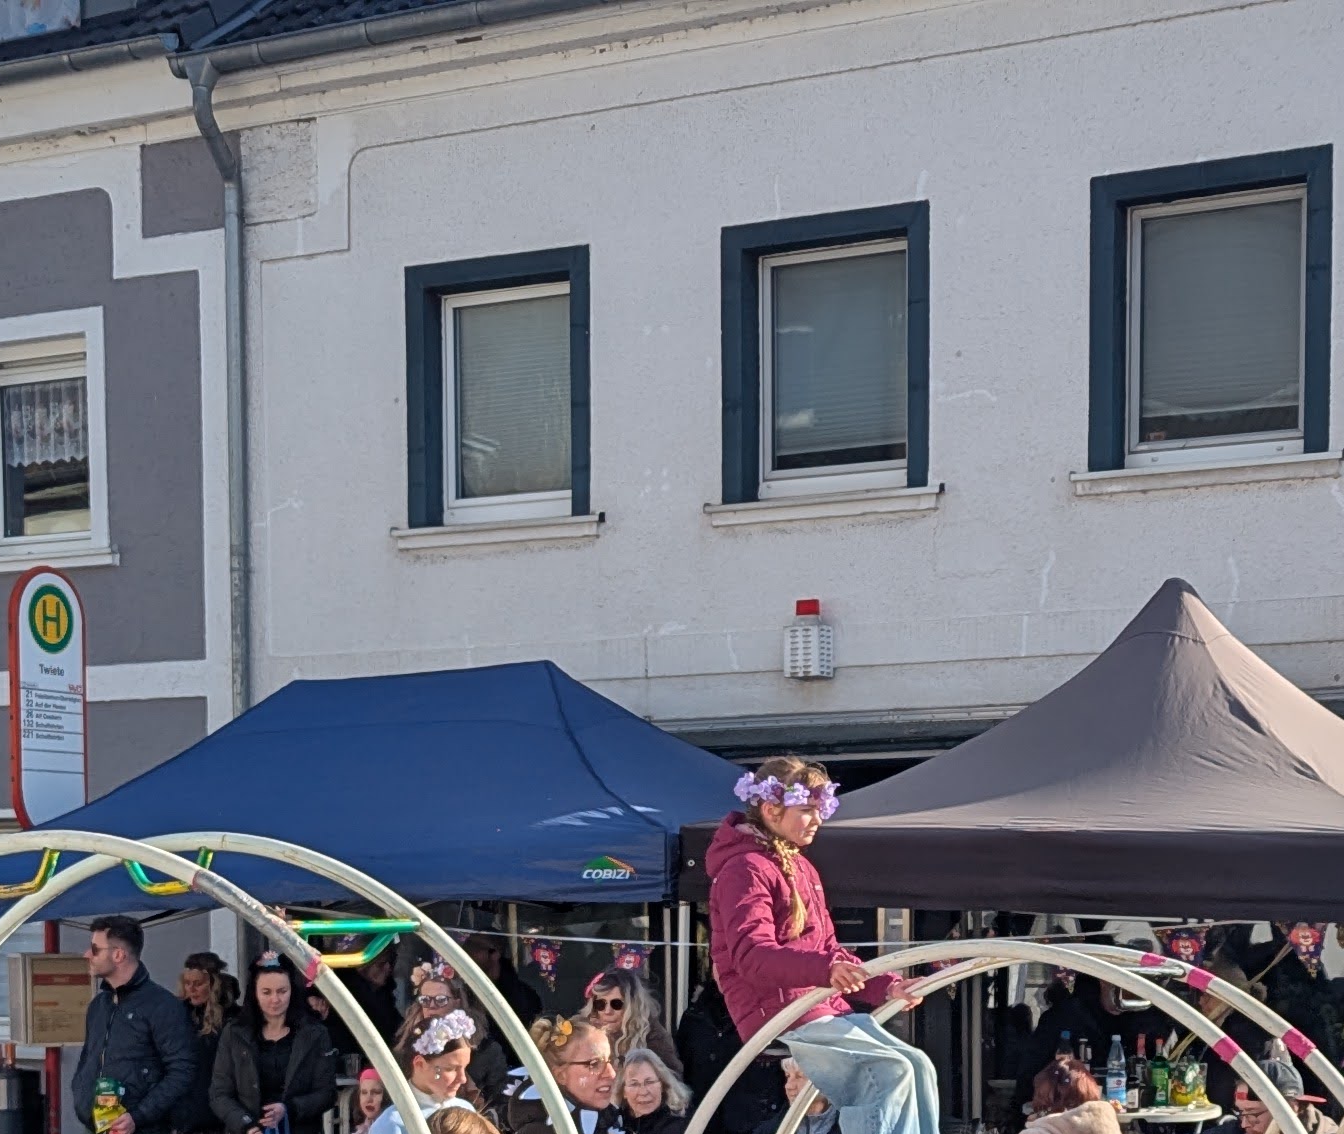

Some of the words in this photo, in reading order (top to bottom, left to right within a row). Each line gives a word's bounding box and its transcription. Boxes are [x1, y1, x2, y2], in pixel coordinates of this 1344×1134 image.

[42, 599, 61, 638] H
[39, 663, 65, 676] Twiete
[582, 868, 631, 880] COBIZI
